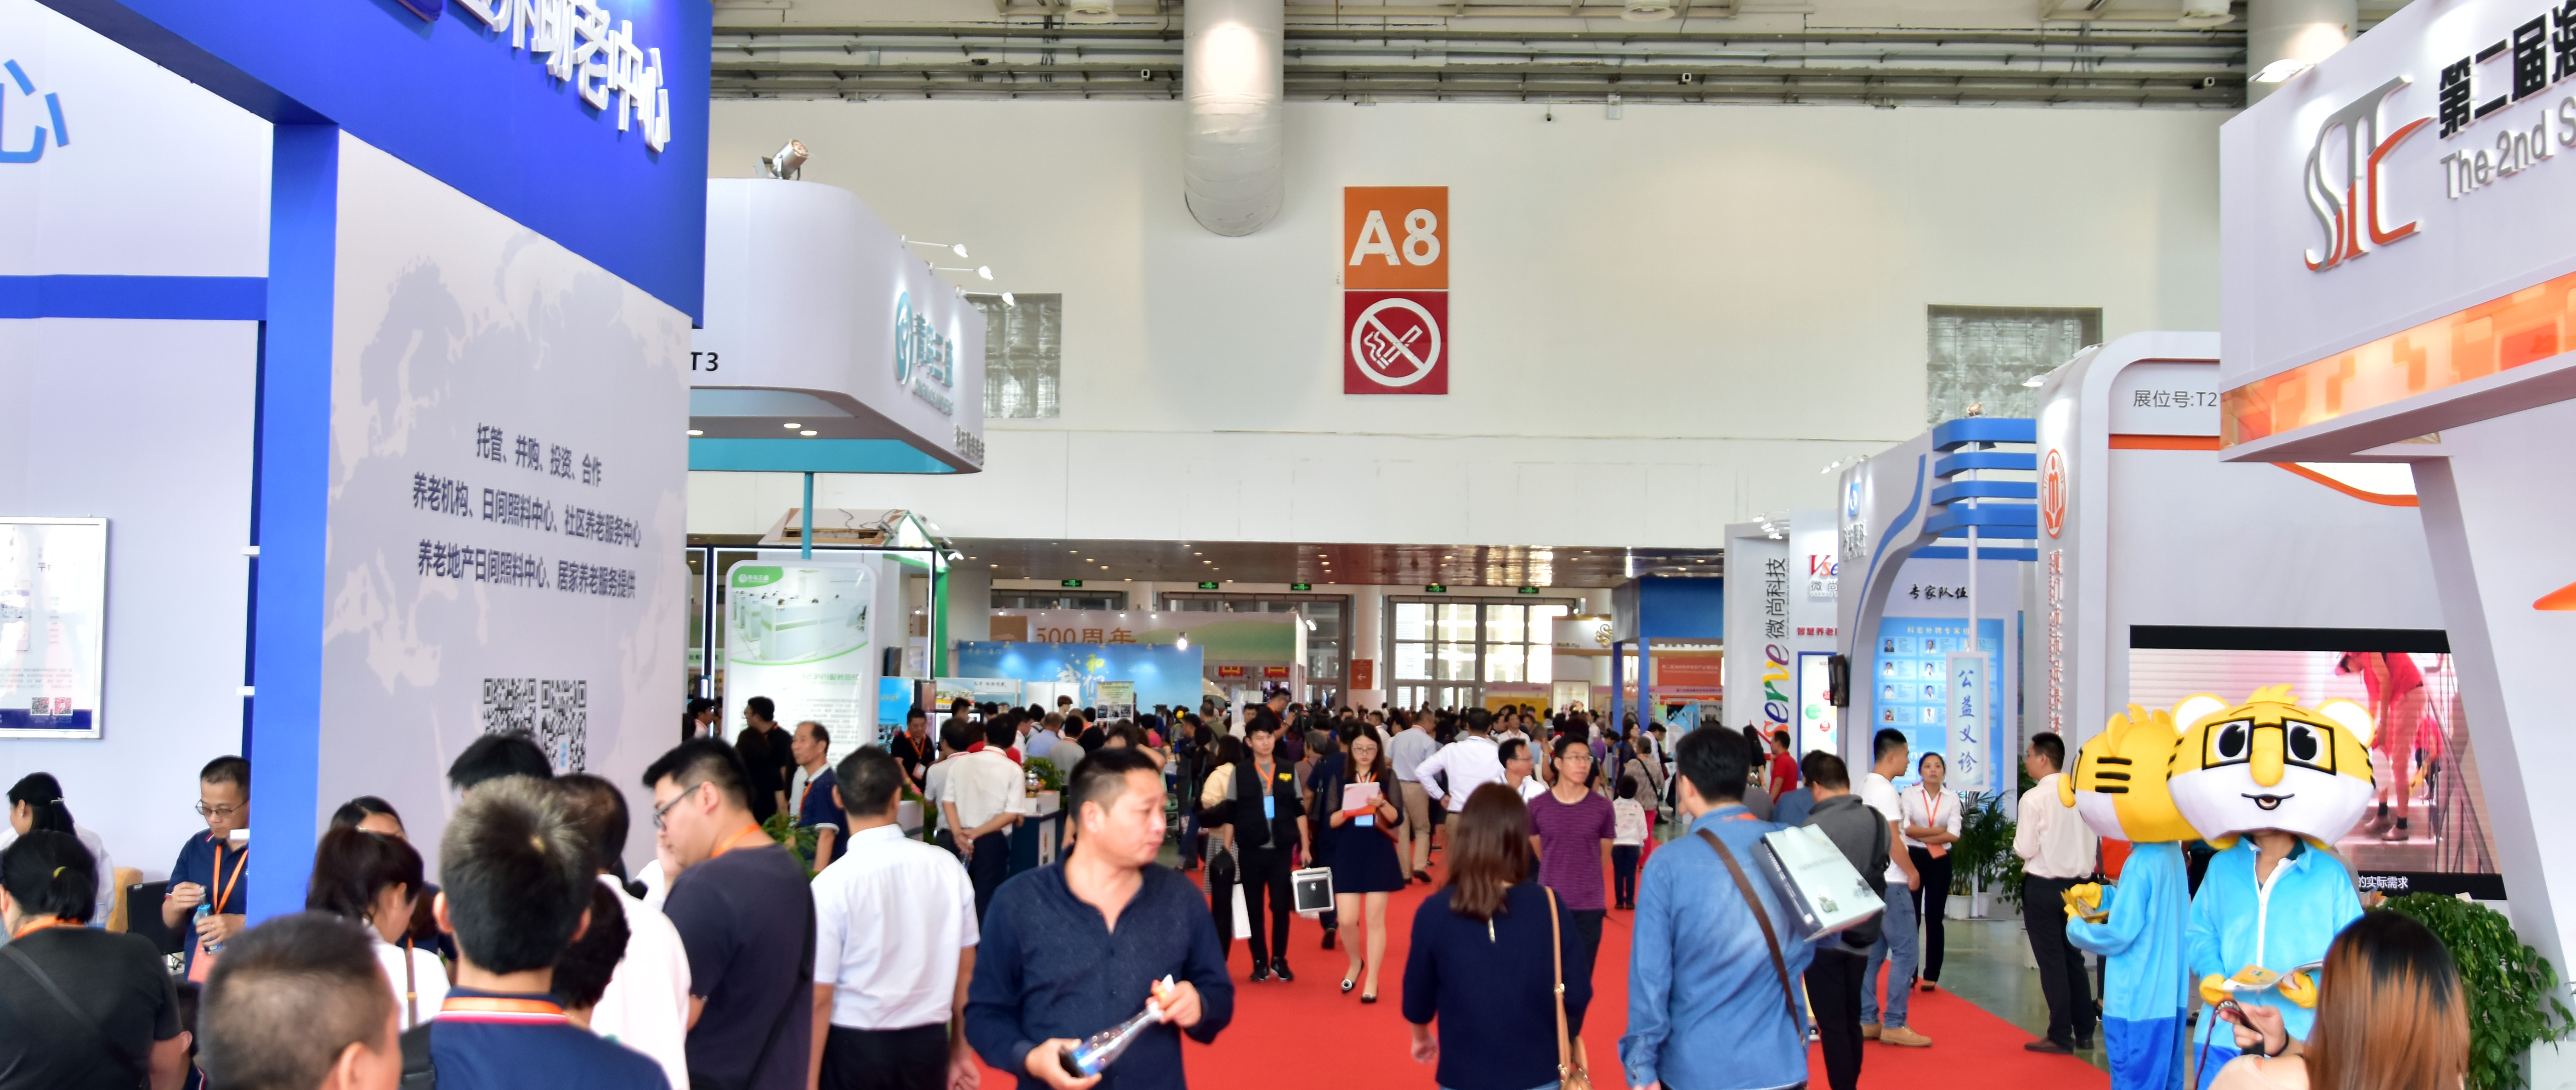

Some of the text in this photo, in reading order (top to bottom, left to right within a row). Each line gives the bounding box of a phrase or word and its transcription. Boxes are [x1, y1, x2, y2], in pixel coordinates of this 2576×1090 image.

[2440, 150, 2490, 199] The
[2497, 110, 2552, 177] 2nd
[1349, 208, 1441, 265] A8
[691, 352, 719, 371] T3
[2134, 390, 2217, 408] 展位号:T2
[1766, 558, 1786, 638] 微尚科技
[1811, 580, 1838, 591] 微尚
[1909, 583, 1969, 599] 专家队伍
[1797, 627, 1838, 635] 智慧养老
[1750, 644, 1789, 760] serve
[1958, 669, 1977, 774] 公益义诊
